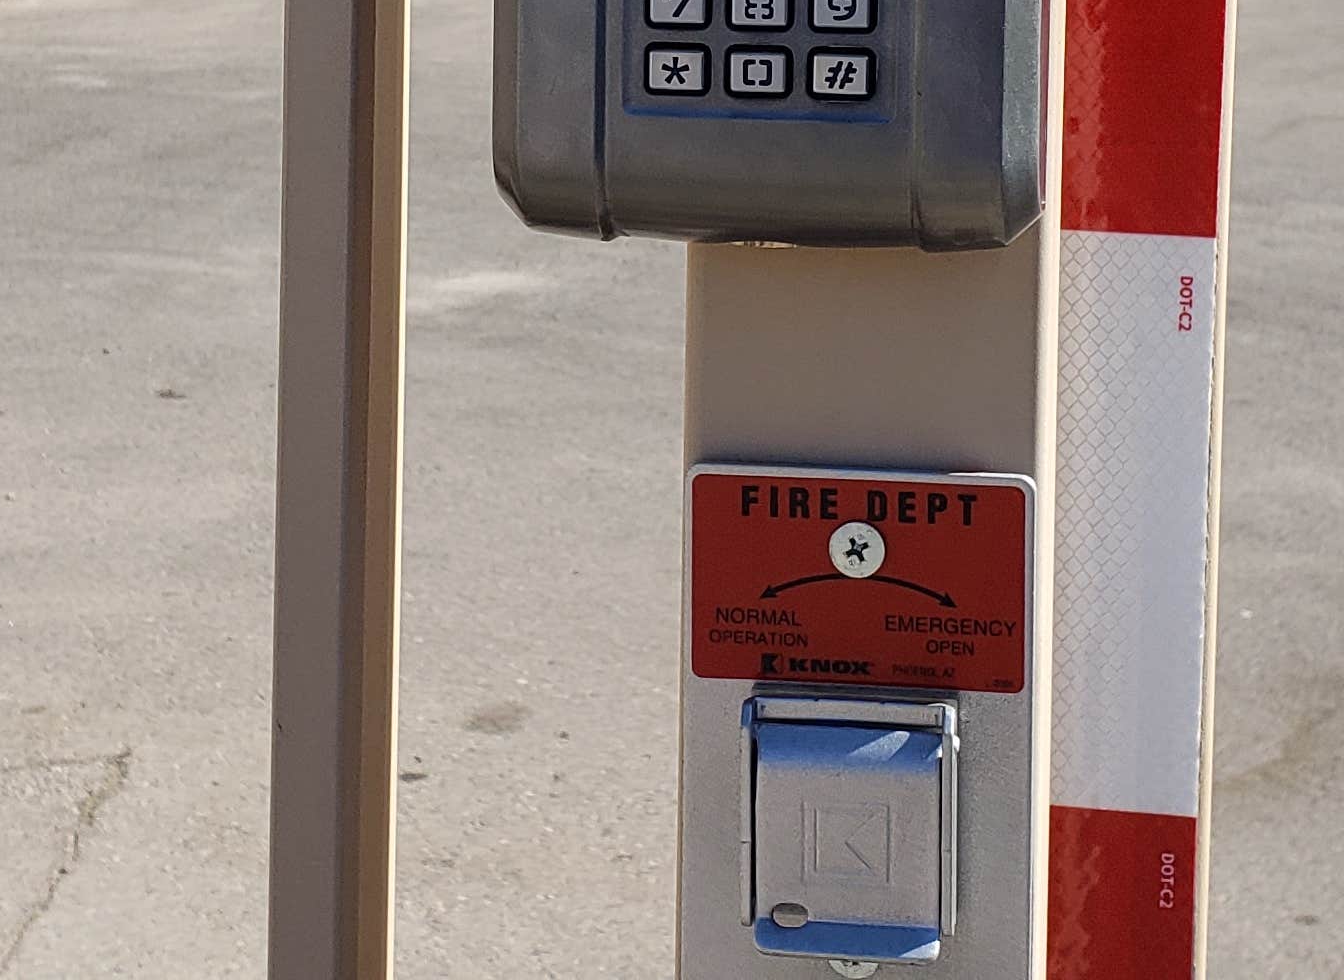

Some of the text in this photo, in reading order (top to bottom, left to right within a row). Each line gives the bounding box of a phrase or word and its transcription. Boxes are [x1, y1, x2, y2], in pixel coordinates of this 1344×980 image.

[824, 60, 858, 89] #
[1178, 275, 1194, 332] DOT-C2
[741, 485, 977, 526] FIRE DEPT
[715, 607, 802, 627] NORMAL
[884, 615, 1017, 638] EMERGENCY
[709, 629, 809, 647] OPERATION
[924, 639, 975, 656] OPEN
[788, 658, 871, 675] KNOX
[1159, 852, 1175, 908] DOT-C2
